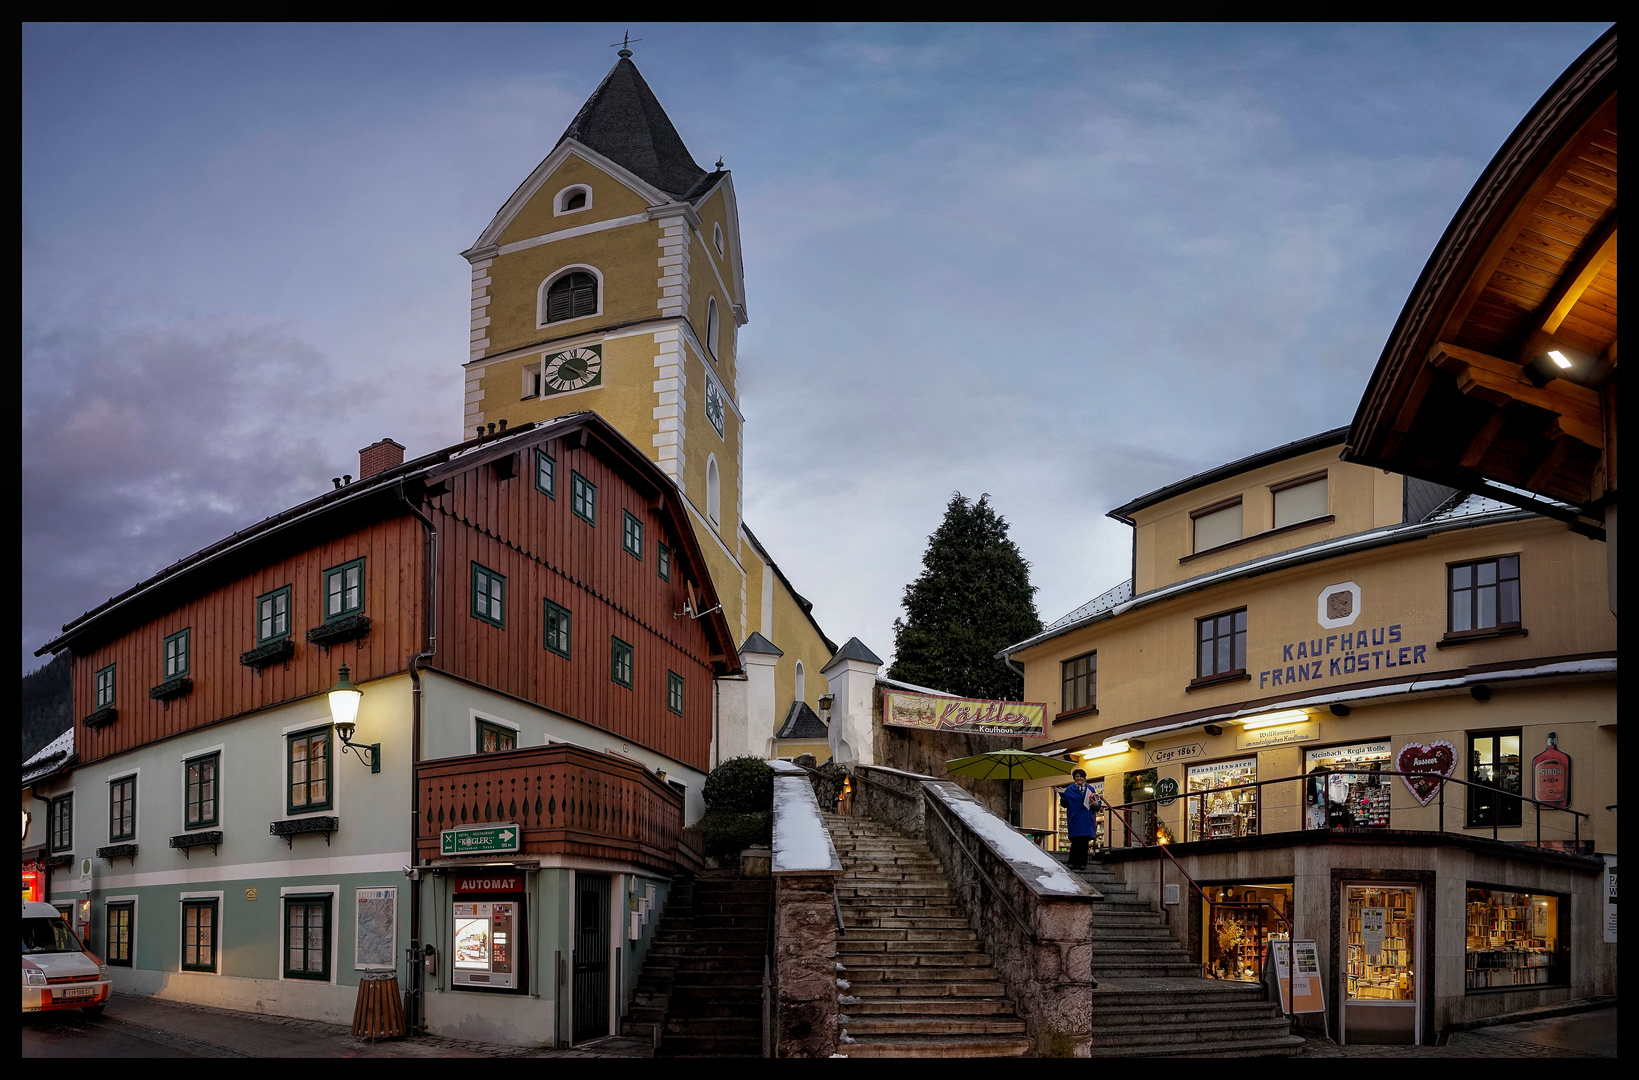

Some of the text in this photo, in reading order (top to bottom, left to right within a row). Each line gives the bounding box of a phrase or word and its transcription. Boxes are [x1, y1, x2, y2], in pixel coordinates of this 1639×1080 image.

[1283, 624, 1402, 662] KAUFHAUS
[1260, 644, 1427, 689] FRANZ KÖSTLER
[935, 701, 1033, 730] Köstler
[979, 726, 1014, 734] Kaufhaus
[1177, 746, 1197, 756] 1865
[1311, 744, 1386, 759] Steinbach Regia Wolle
[1191, 761, 1252, 774] Haushaltswaren
[1540, 768, 1562, 776] STROH
[1160, 782, 1174, 792] 149
[461, 879, 516, 890] AUTOMAT
